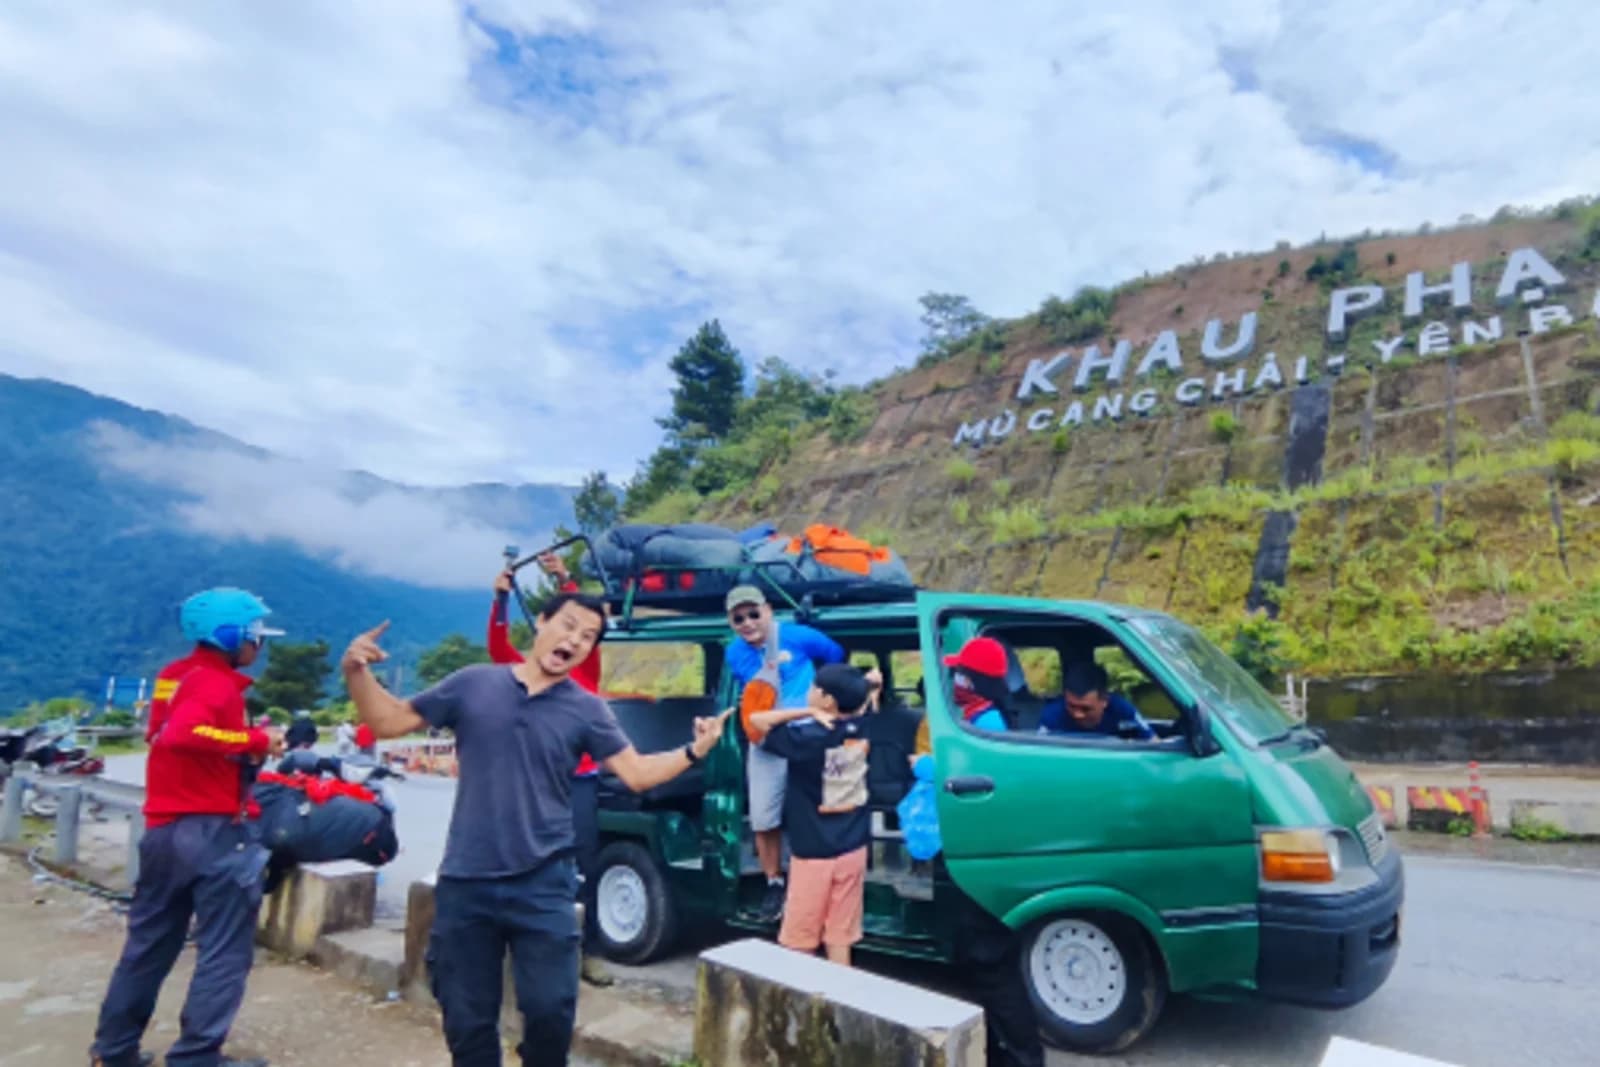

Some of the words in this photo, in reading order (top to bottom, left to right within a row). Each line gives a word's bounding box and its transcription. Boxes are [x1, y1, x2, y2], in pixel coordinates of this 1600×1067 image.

[1016, 311, 1258, 400] KHAU
[1326, 247, 1567, 333] PHẠ
[1027, 388, 1158, 431] CANG
[1371, 316, 1502, 363] YÊN
